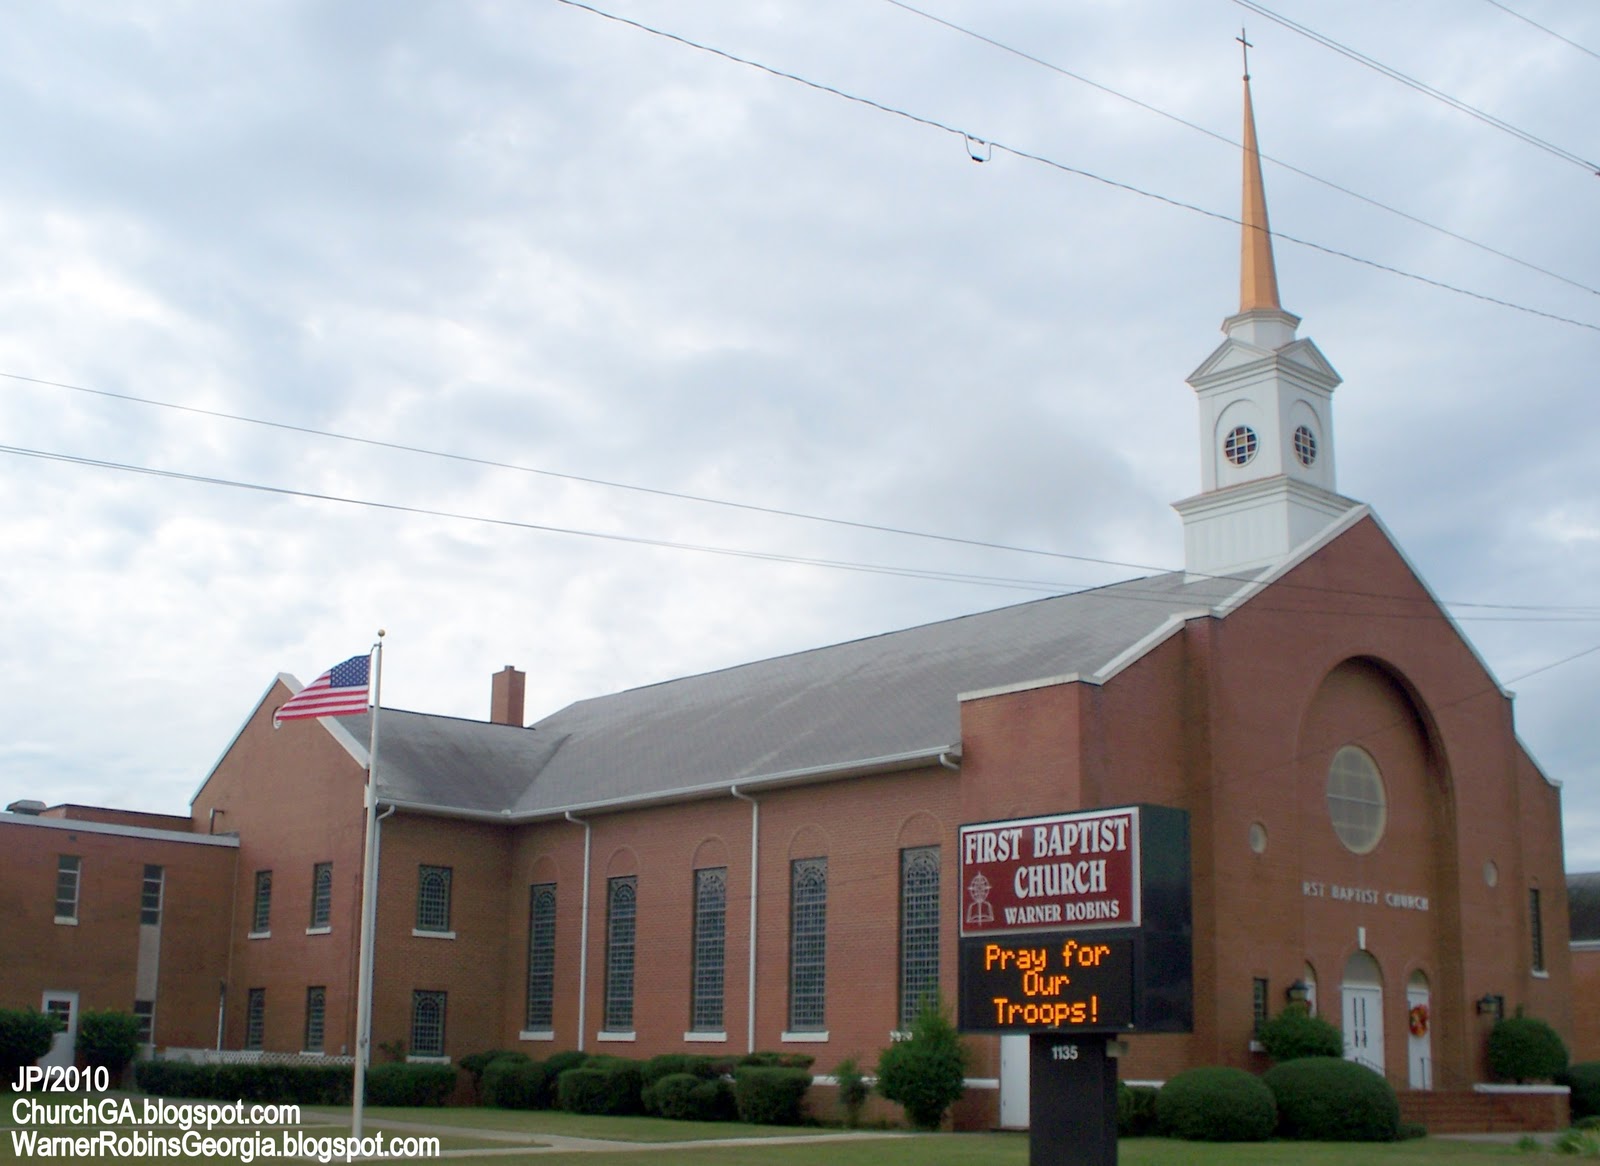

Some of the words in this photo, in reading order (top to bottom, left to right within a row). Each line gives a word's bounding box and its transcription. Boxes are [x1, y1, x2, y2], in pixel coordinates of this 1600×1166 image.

[965, 829, 1022, 865] FIRST
[1033, 817, 1129, 859] BAPTIST
[1014, 859, 1107, 899] CHURCH
[1004, 903, 1061, 925] WARNER
[1066, 899, 1120, 922] ROBINS
[1331, 884, 1379, 905] BAPTIST
[1385, 892, 1429, 911] CHURCH
[986, 945, 1046, 972] Pray
[1062, 940, 1110, 967] for
[1023, 970, 1070, 996] Our
[993, 995, 1098, 1027] Troops!
[1052, 1045, 1078, 1060] 1135
